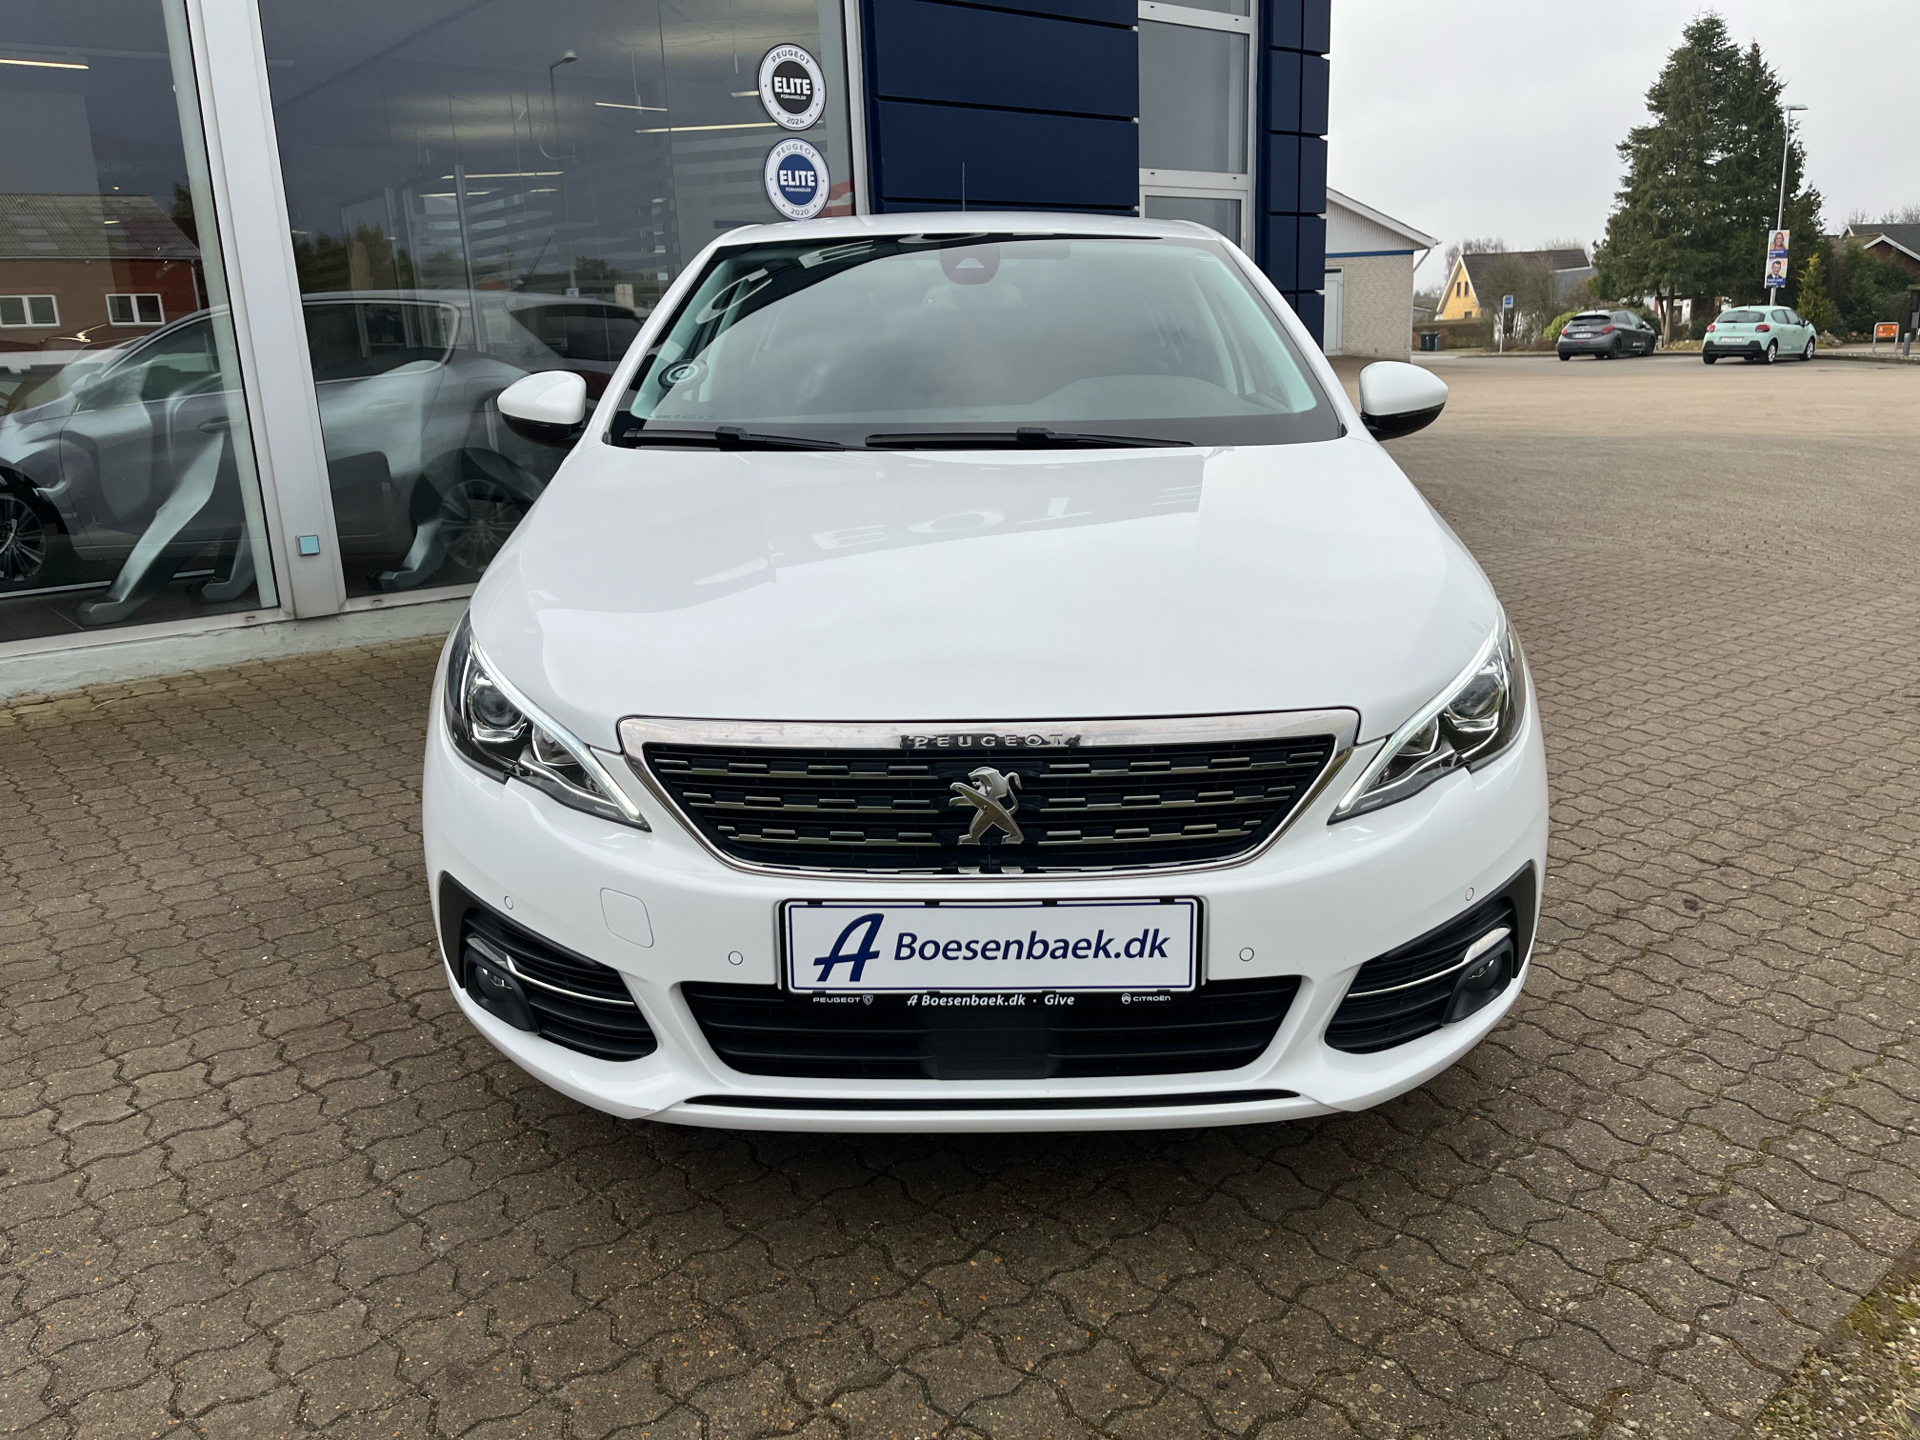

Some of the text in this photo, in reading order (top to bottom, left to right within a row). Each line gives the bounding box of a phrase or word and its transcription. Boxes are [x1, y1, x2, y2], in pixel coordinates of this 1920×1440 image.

[771, 49, 811, 65] PEUGEOT
[773, 76, 811, 95] ELITE
[786, 117, 805, 125] 2024
[776, 143, 816, 159] PEUGEOT
[779, 169, 816, 187] ELITE
[790, 208, 809, 216] 2020
[913, 734, 1064, 748] PEUGEOT
[894, 928, 1171, 961] Boesenbaek.dk
[921, 993, 1026, 1006] Boesenbaek.dk
[1044, 994, 1075, 1006] Give
